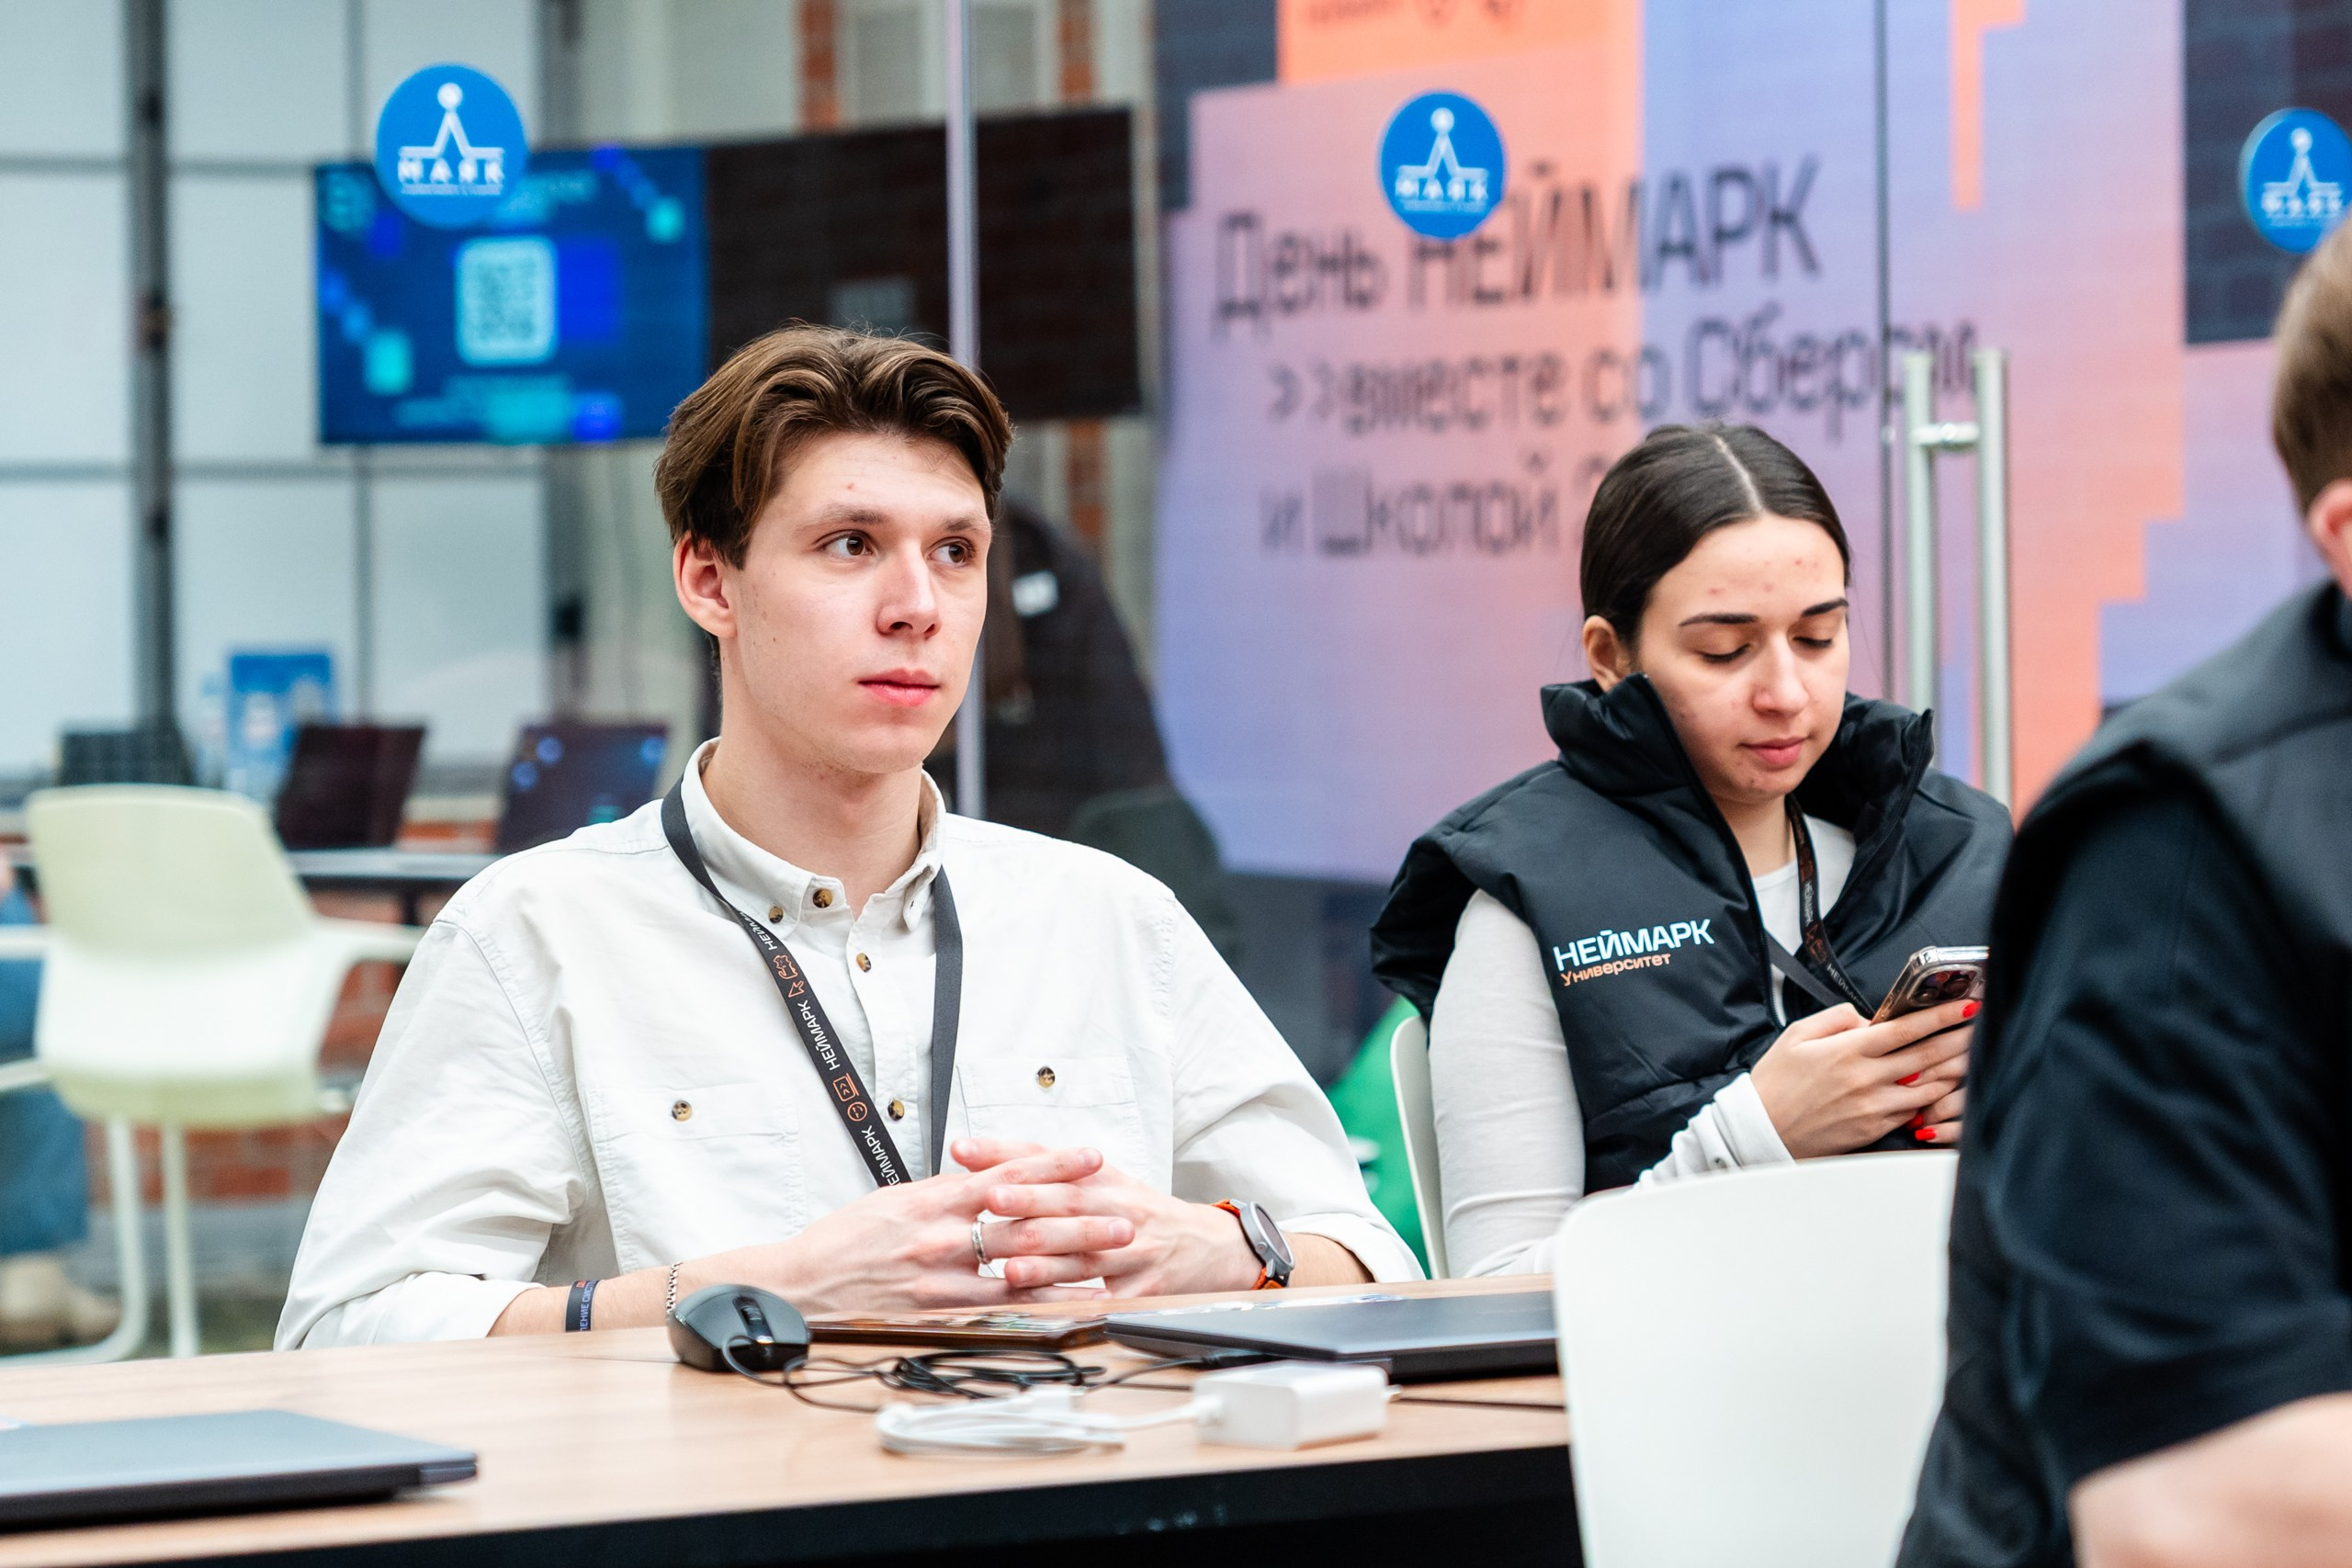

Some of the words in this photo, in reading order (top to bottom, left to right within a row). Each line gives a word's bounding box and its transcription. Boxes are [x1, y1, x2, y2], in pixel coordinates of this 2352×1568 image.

[1215, 209, 1388, 338] День
[1553, 919, 1715, 972] НЕЙМАРК
[1561, 953, 1671, 987] Университет
[797, 999, 841, 1071] НЕЙМАРК
[861, 1124, 900, 1186] ЕЙМАРК
